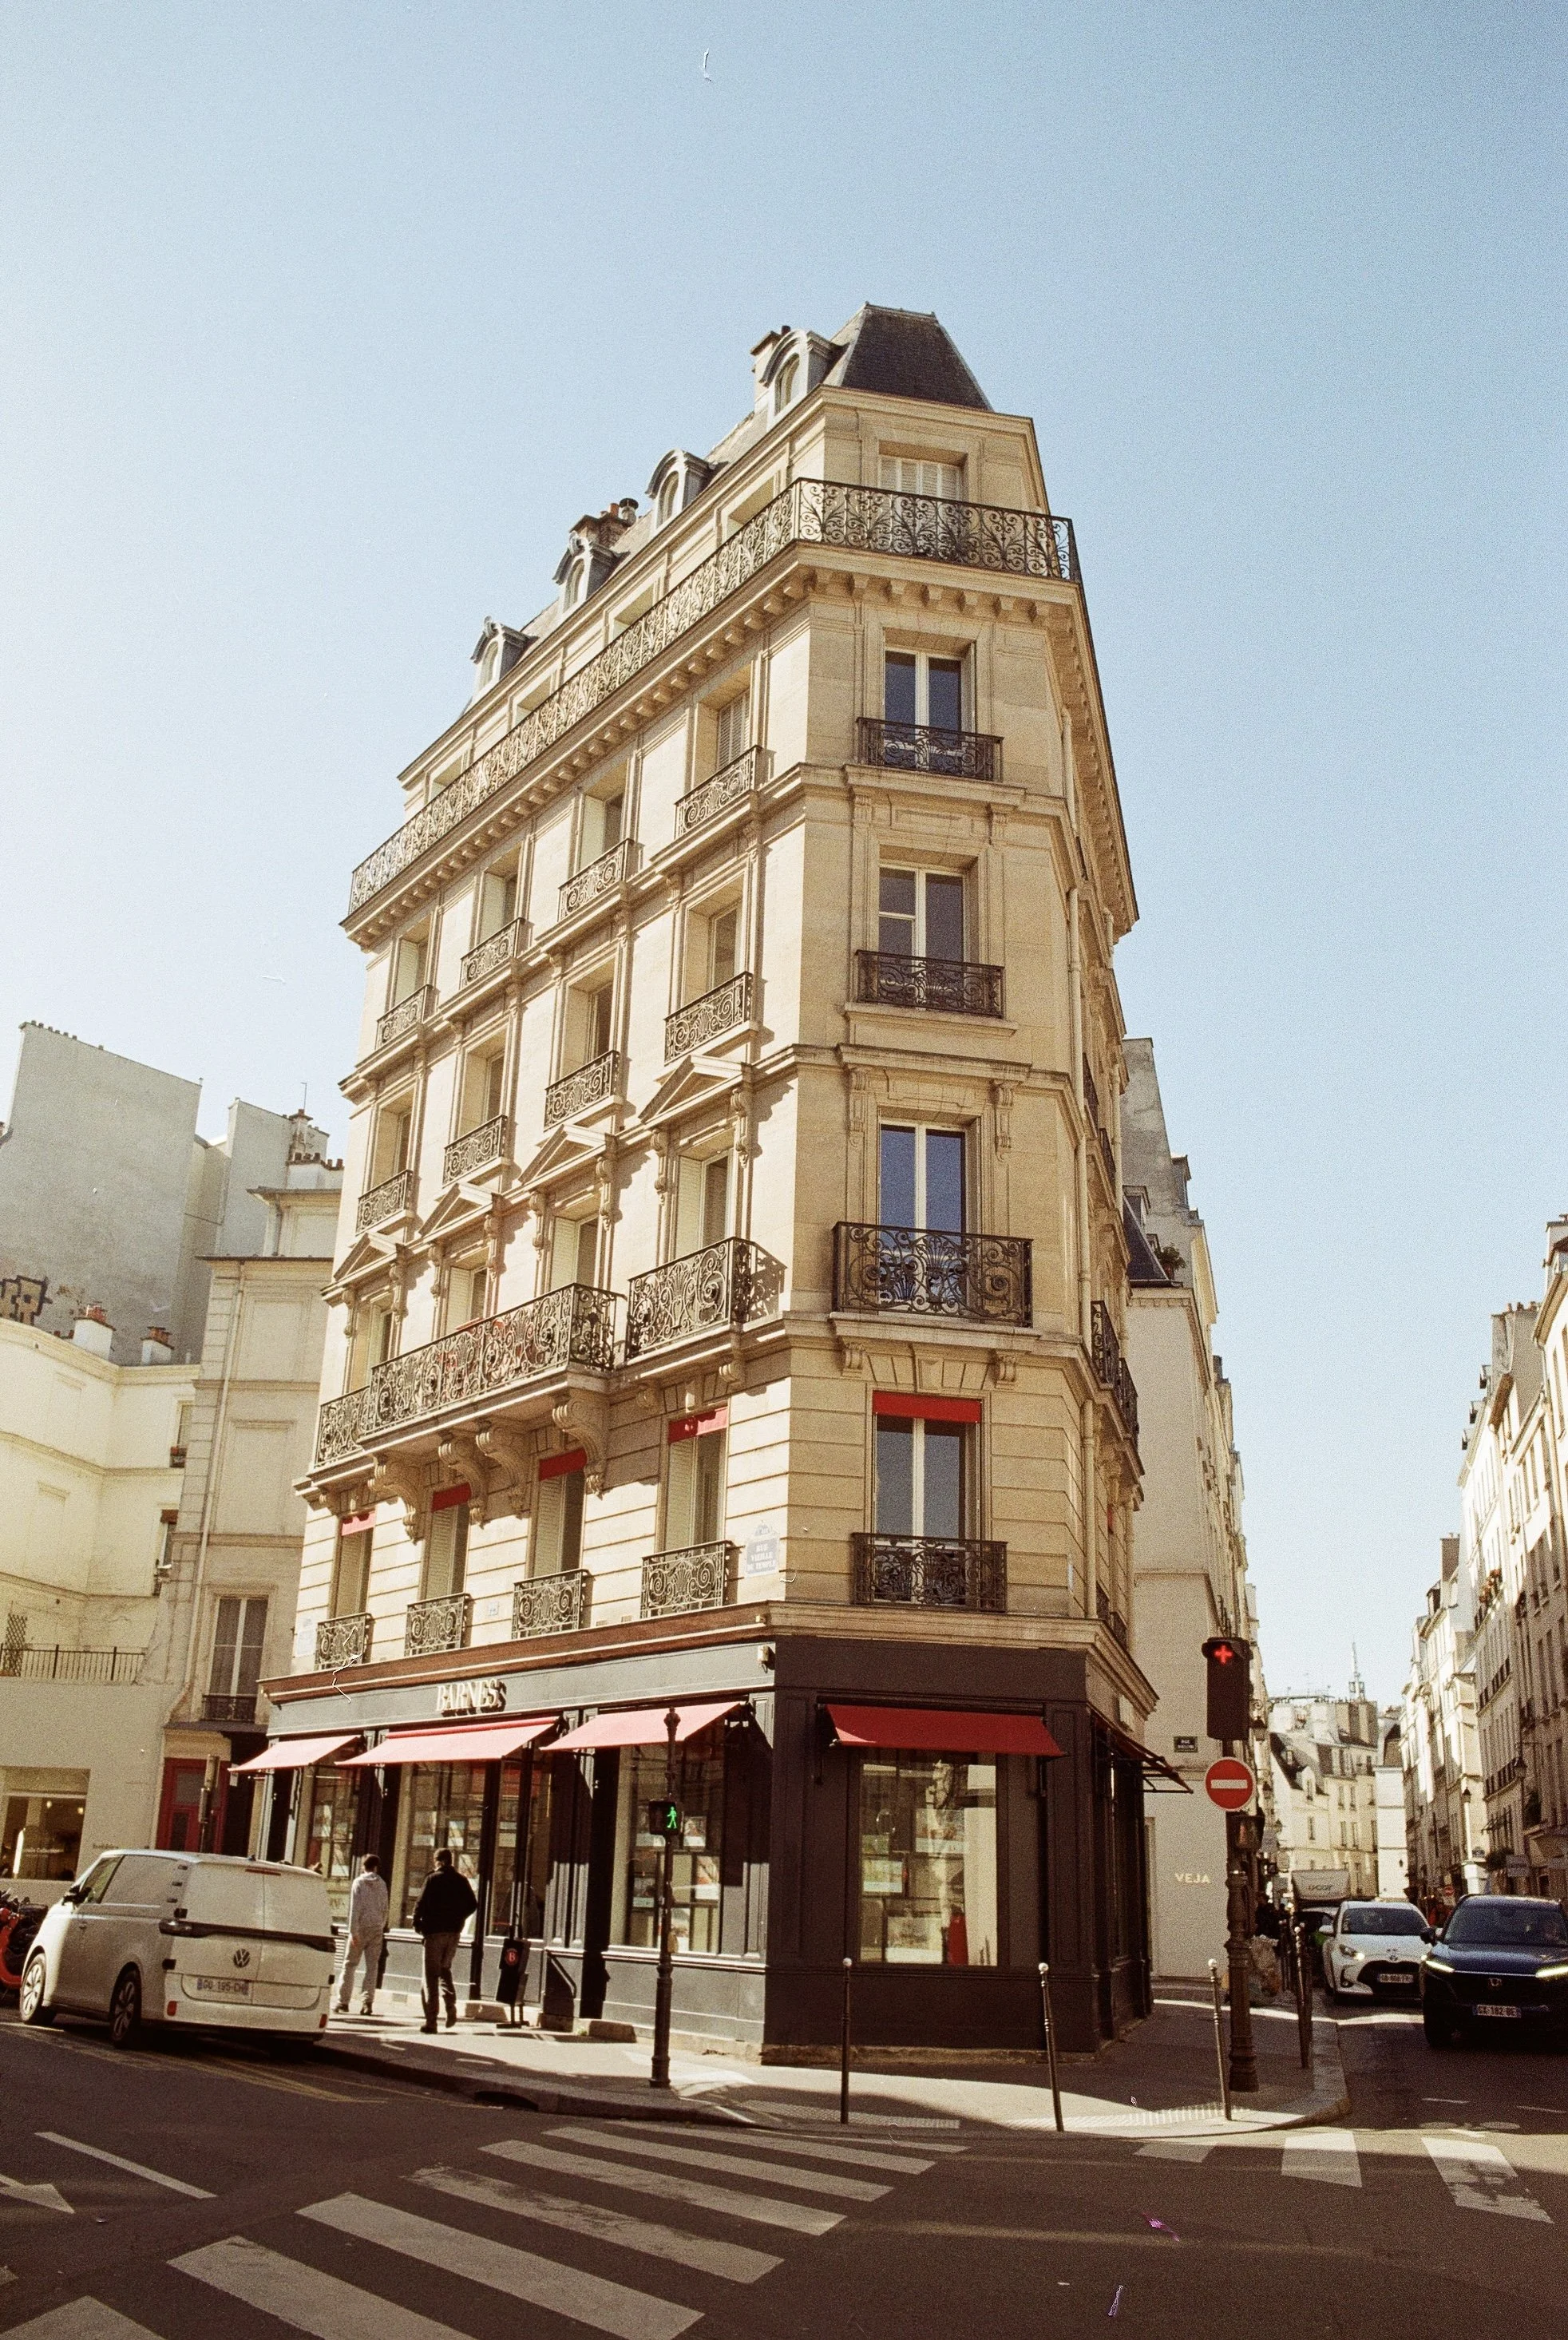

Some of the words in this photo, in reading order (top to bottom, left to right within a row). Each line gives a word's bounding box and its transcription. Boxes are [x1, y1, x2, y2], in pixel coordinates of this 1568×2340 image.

[755, 1543, 768, 1552] RUE
[750, 1551, 773, 1562] VIEILLE
[755, 1559, 776, 1570] TEMPLE
[436, 1678, 498, 1711] BARNES
[1174, 1873, 1211, 1884] VEJA
